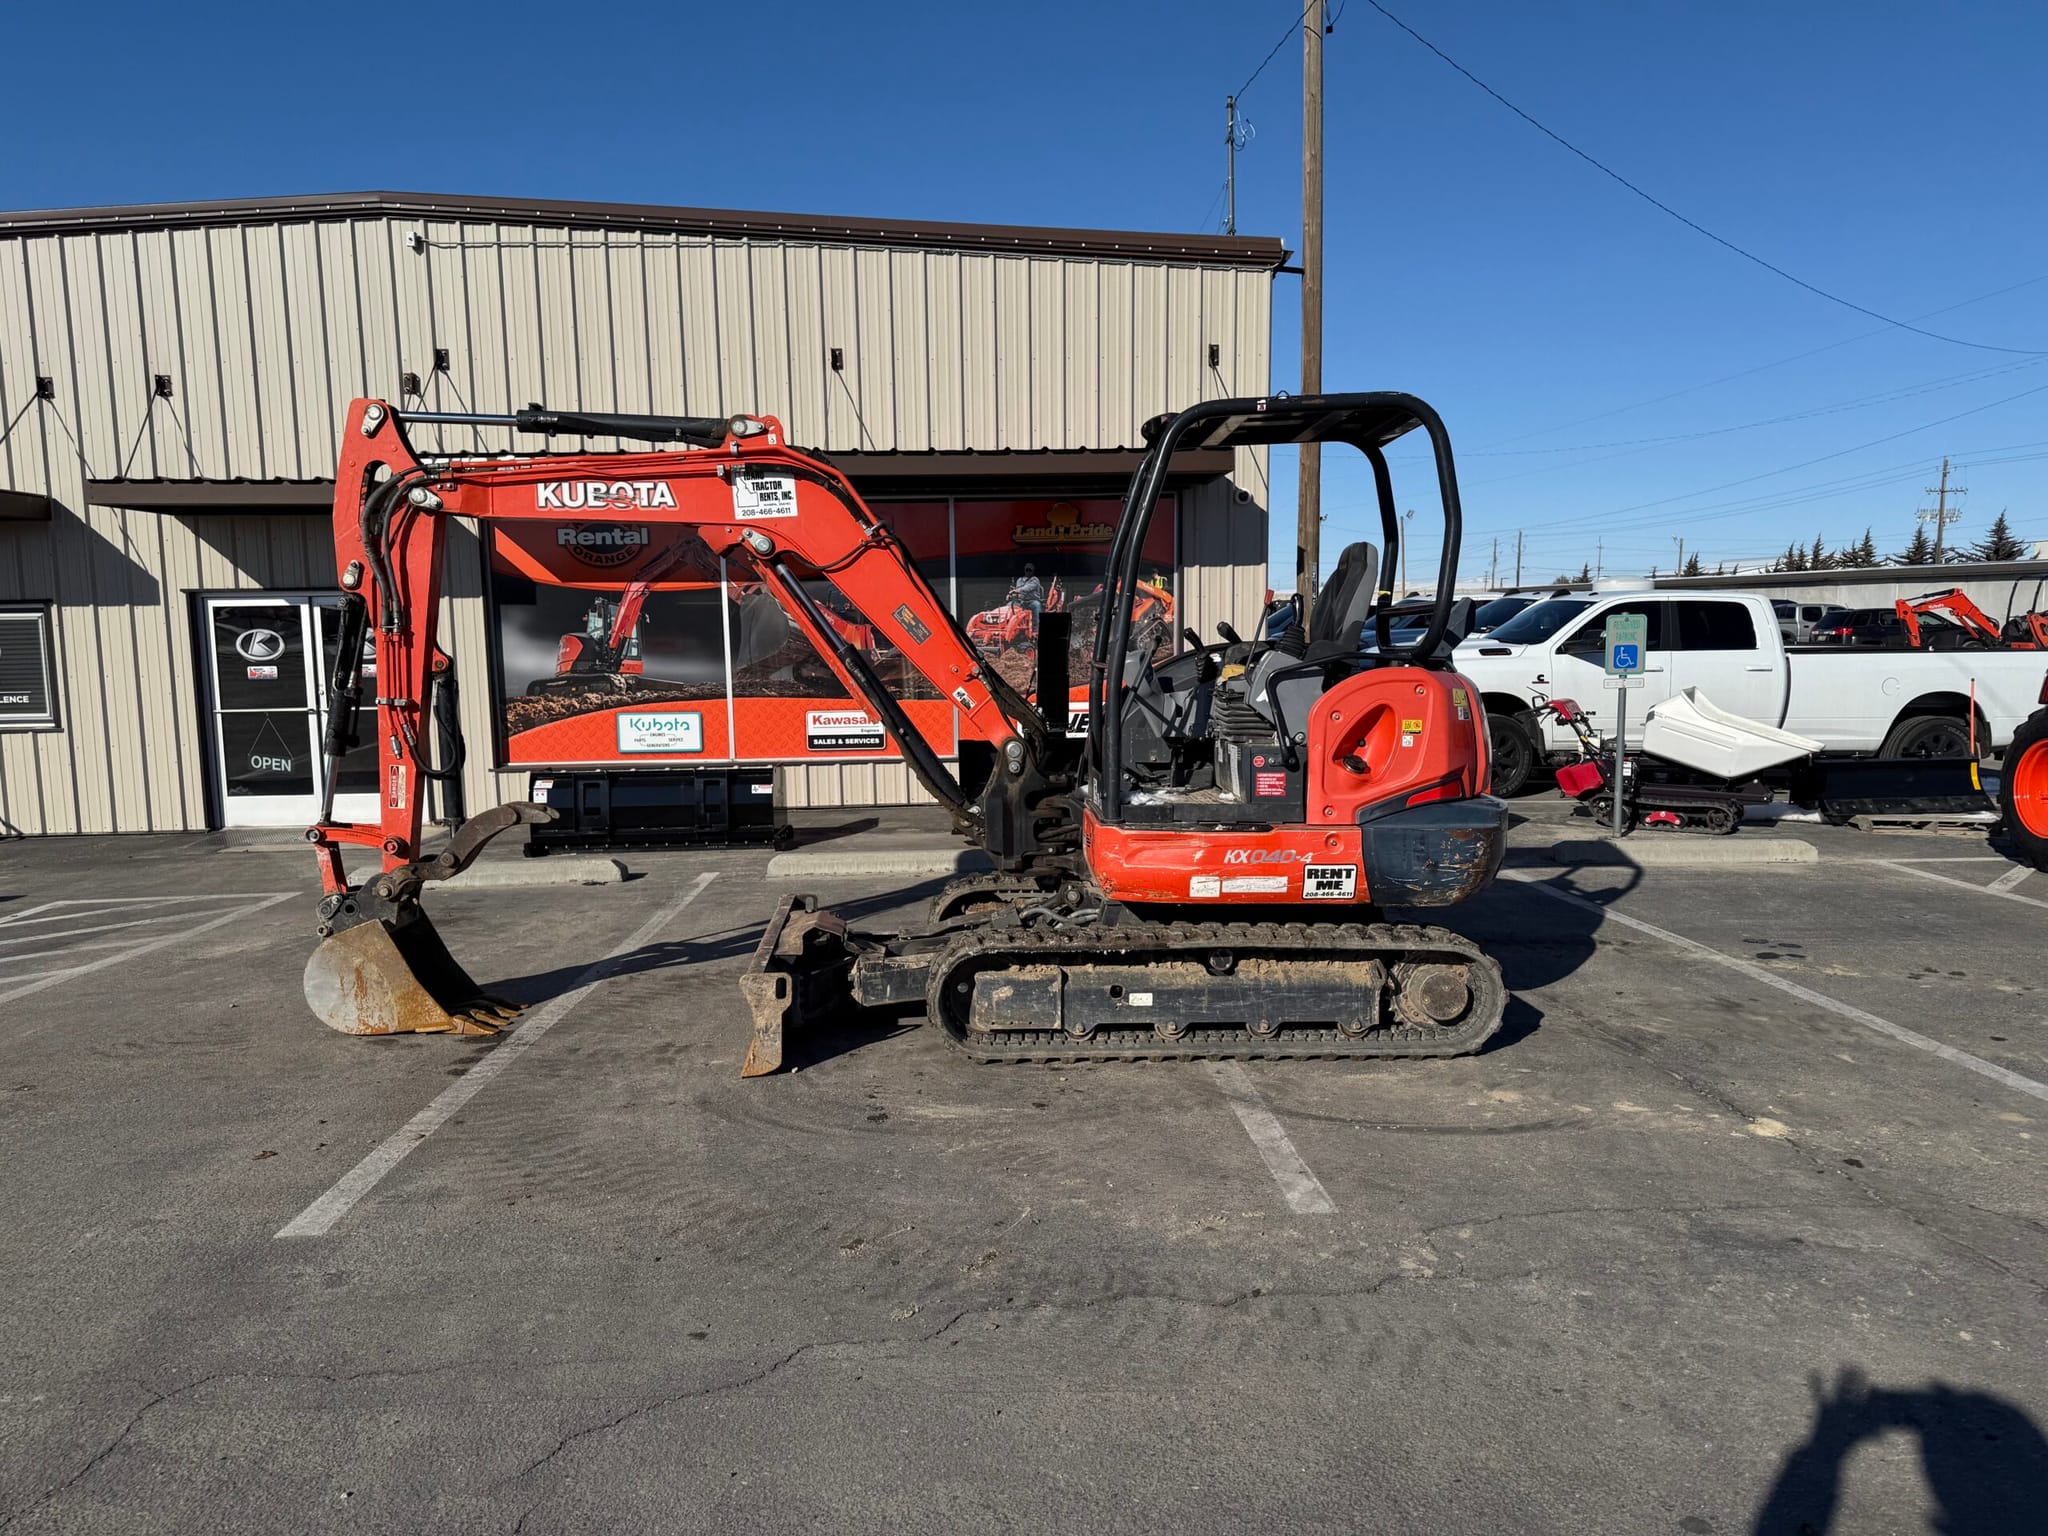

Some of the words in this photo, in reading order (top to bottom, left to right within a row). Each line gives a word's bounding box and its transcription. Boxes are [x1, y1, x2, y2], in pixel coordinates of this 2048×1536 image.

[751, 480, 782, 491] TRACTOR
[537, 481, 677, 508] KUBOTA
[759, 491, 780, 502] RENTS,
[781, 490, 794, 500] INC.
[741, 507, 791, 517] 208-466-4611
[557, 527, 649, 545] Rental
[1015, 524, 1056, 537] Land
[1068, 523, 1114, 537] Pride
[574, 546, 635, 564] ORANGE
[629, 717, 690, 732] Kubota
[812, 714, 880, 726] Kawasa
[251, 755, 291, 772] OPEN
[1223, 849, 1314, 864] KX040-4
[1306, 868, 1355, 879] RENT
[1315, 880, 1344, 890] ME
